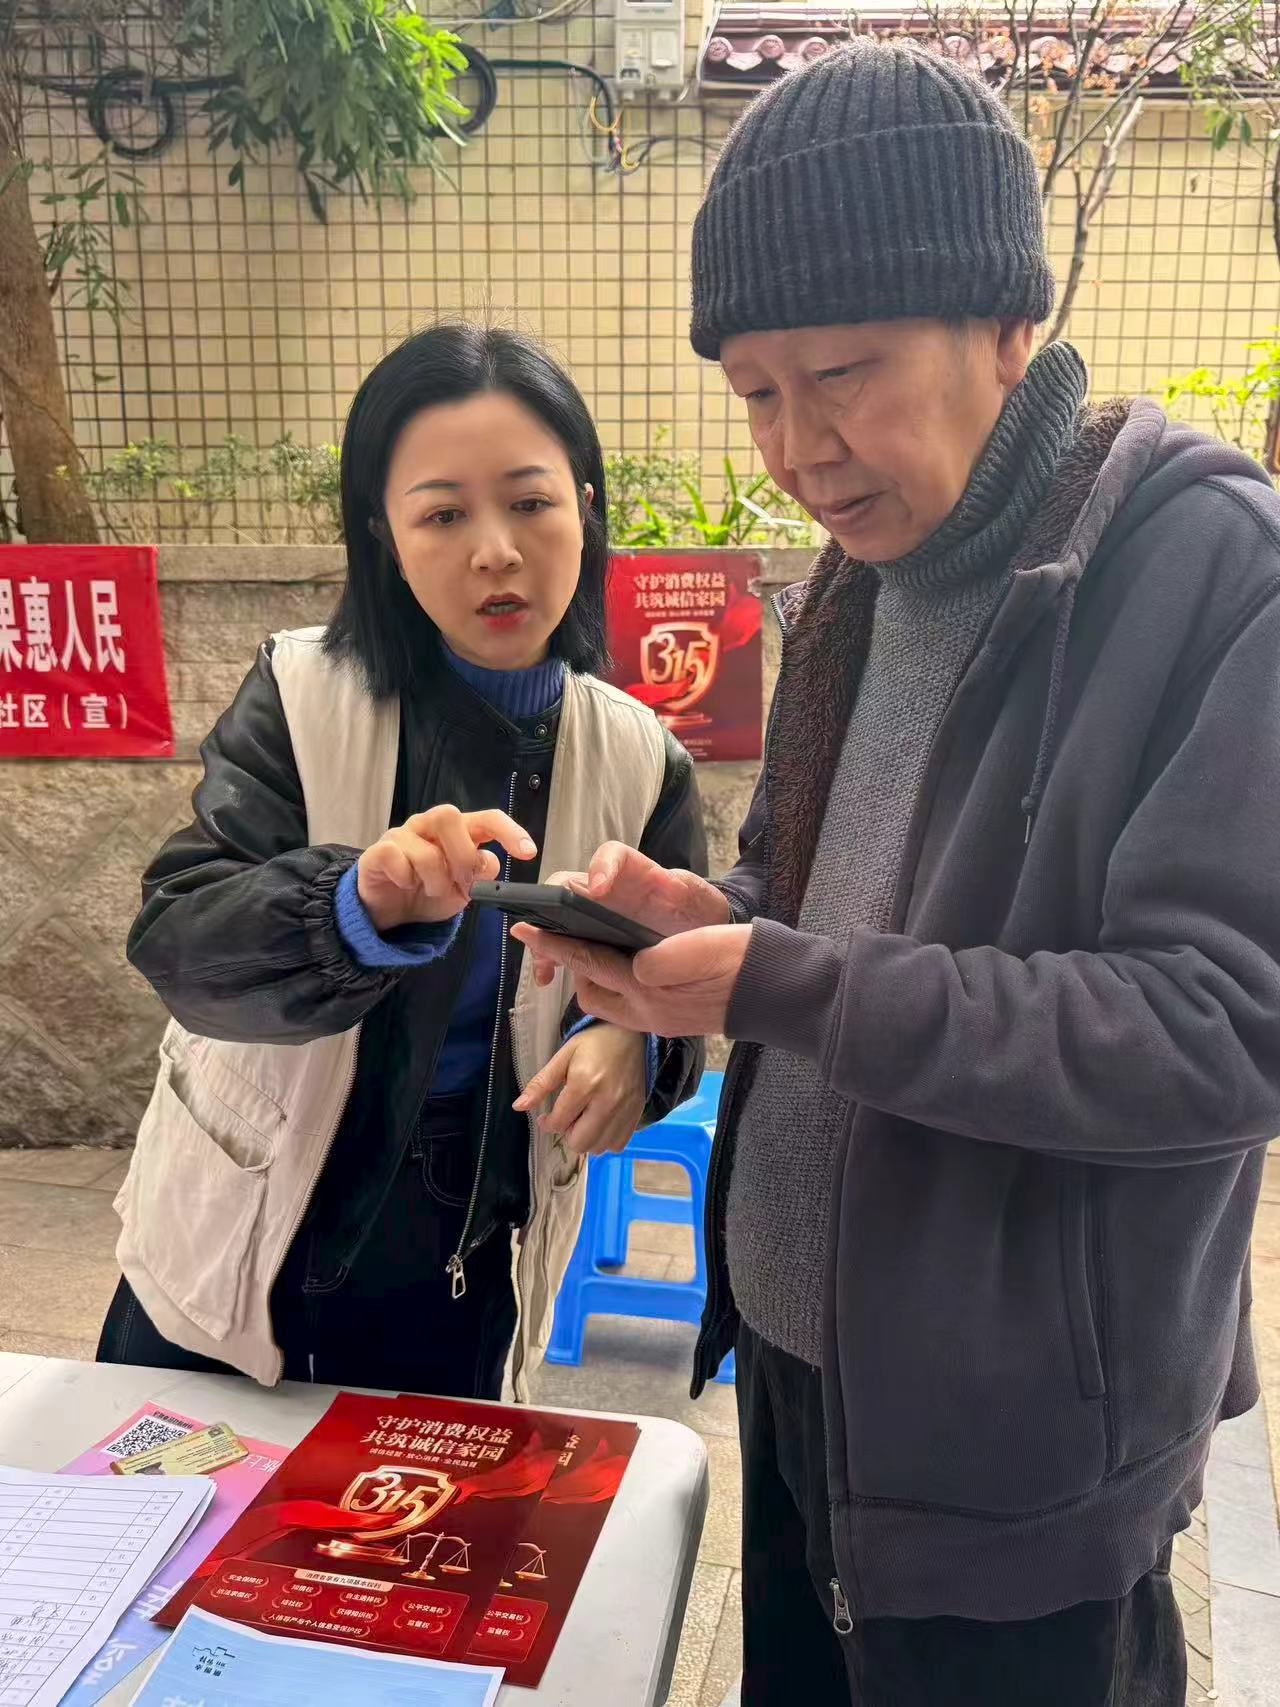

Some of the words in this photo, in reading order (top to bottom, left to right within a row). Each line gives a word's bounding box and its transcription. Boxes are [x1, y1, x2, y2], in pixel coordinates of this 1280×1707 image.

[634, 572, 726, 590] 守护消费权益
[650, 632, 710, 689] 315
[360, 1429, 506, 1461] 共筑诚信家园
[377, 1414, 514, 1445] 守护消费权益
[350, 1473, 440, 1526] 315
[407, 1603, 445, 1615] 公平交易权
[486, 1609, 525, 1621] 公平交易权
